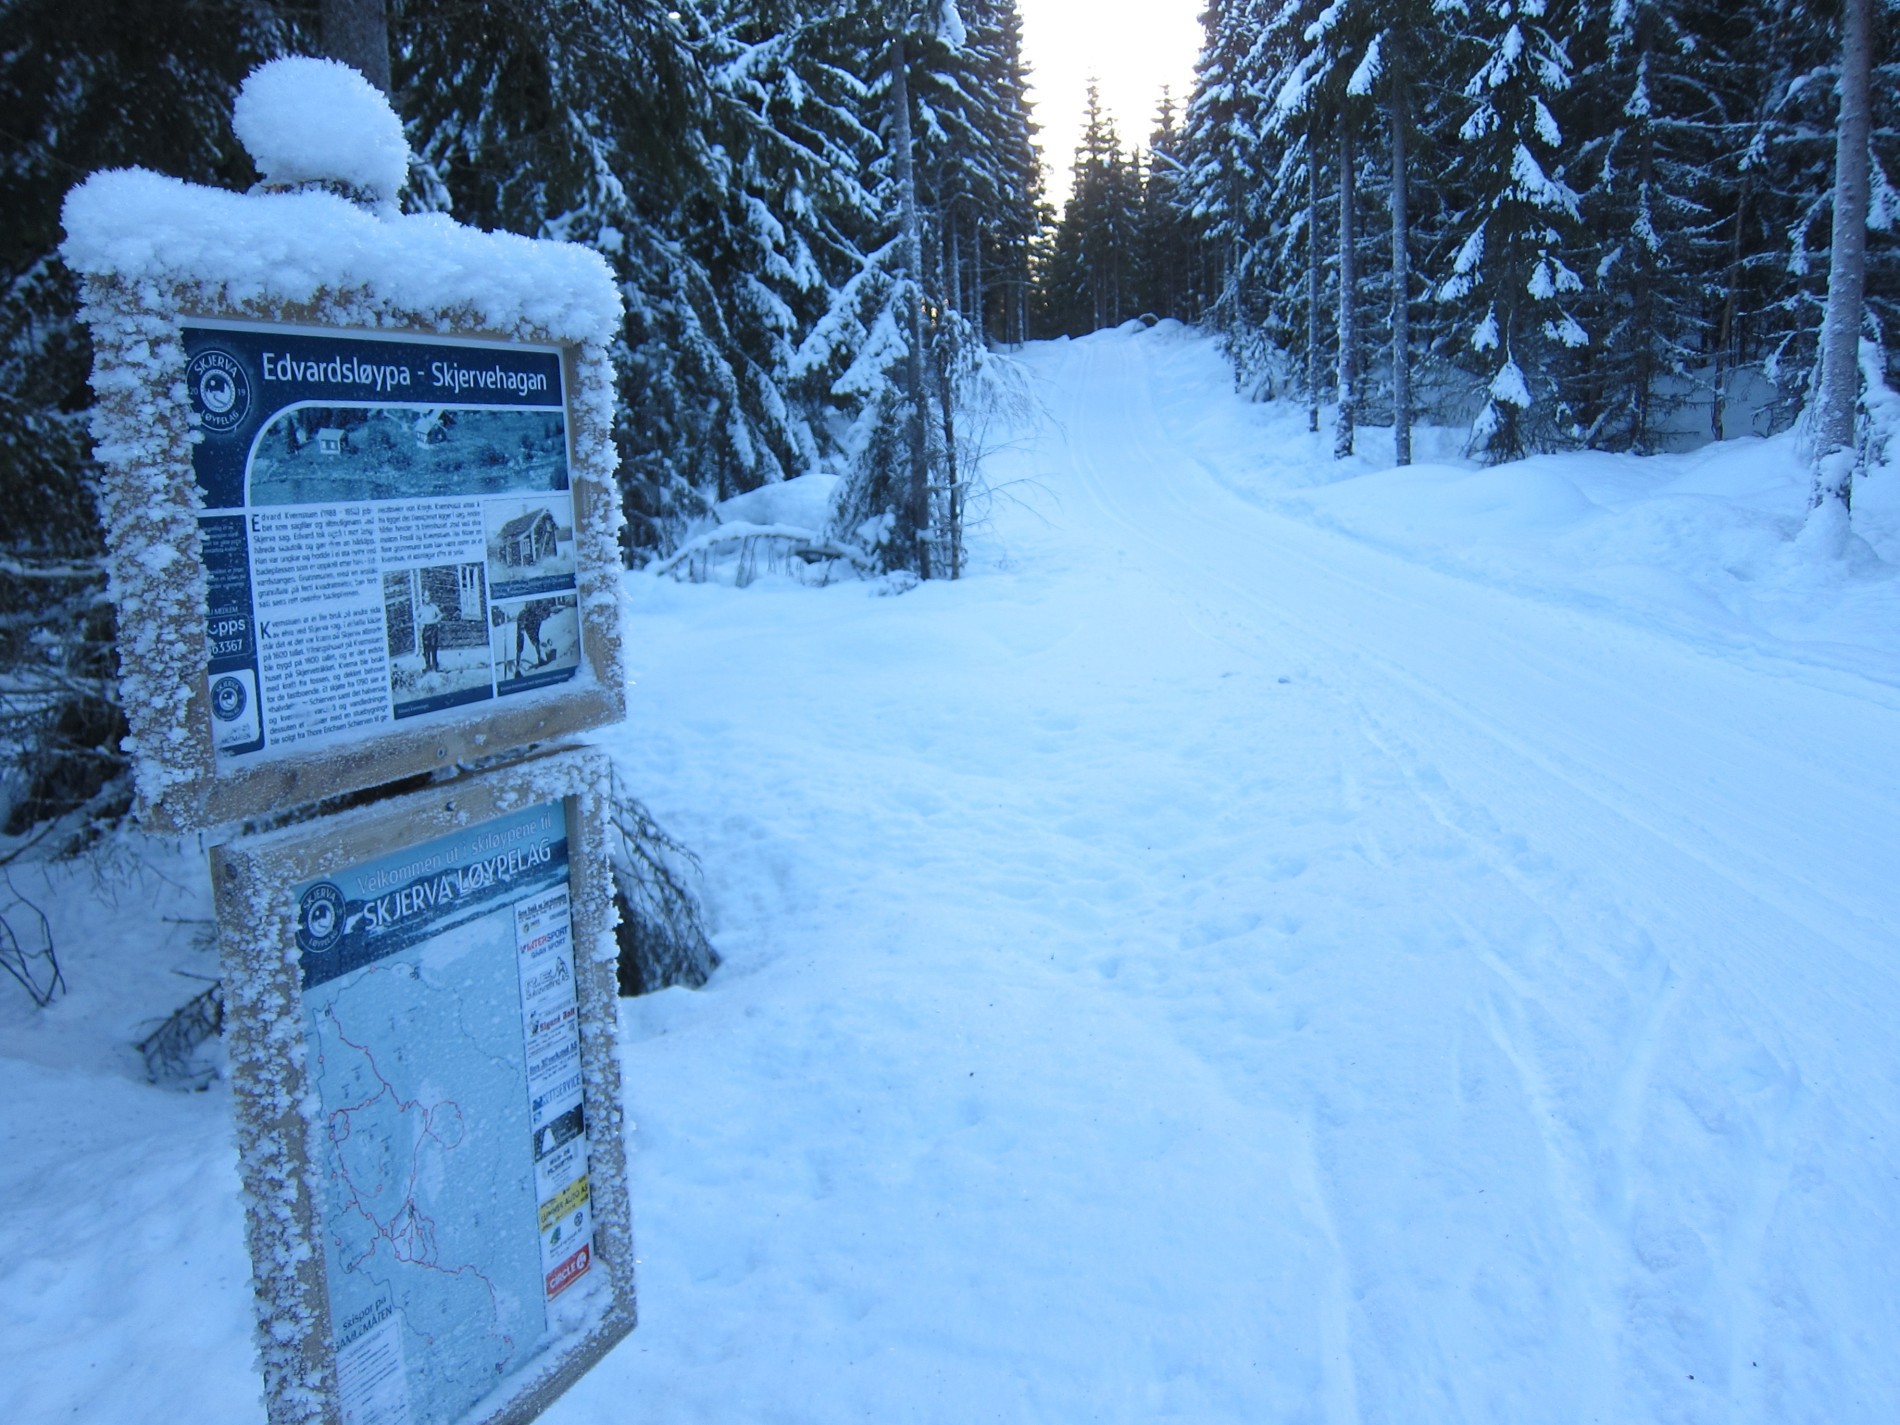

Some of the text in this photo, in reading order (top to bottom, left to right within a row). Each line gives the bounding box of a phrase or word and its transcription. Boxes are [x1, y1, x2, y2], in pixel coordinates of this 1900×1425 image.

[194, 355, 238, 378] SKJERVA
[262, 352, 411, 392] Edvardsløypa
[431, 362, 548, 396] Skjervehagan
[356, 855, 442, 895] Velkommen
[471, 821, 537, 856] skiløypene
[363, 875, 453, 930] SKJERVA
[458, 838, 551, 894] LØYPELAG
[303, 888, 337, 910] SKJERVA
[549, 1264, 576, 1289] CIRCLE
[342, 1304, 373, 1332] skispor
